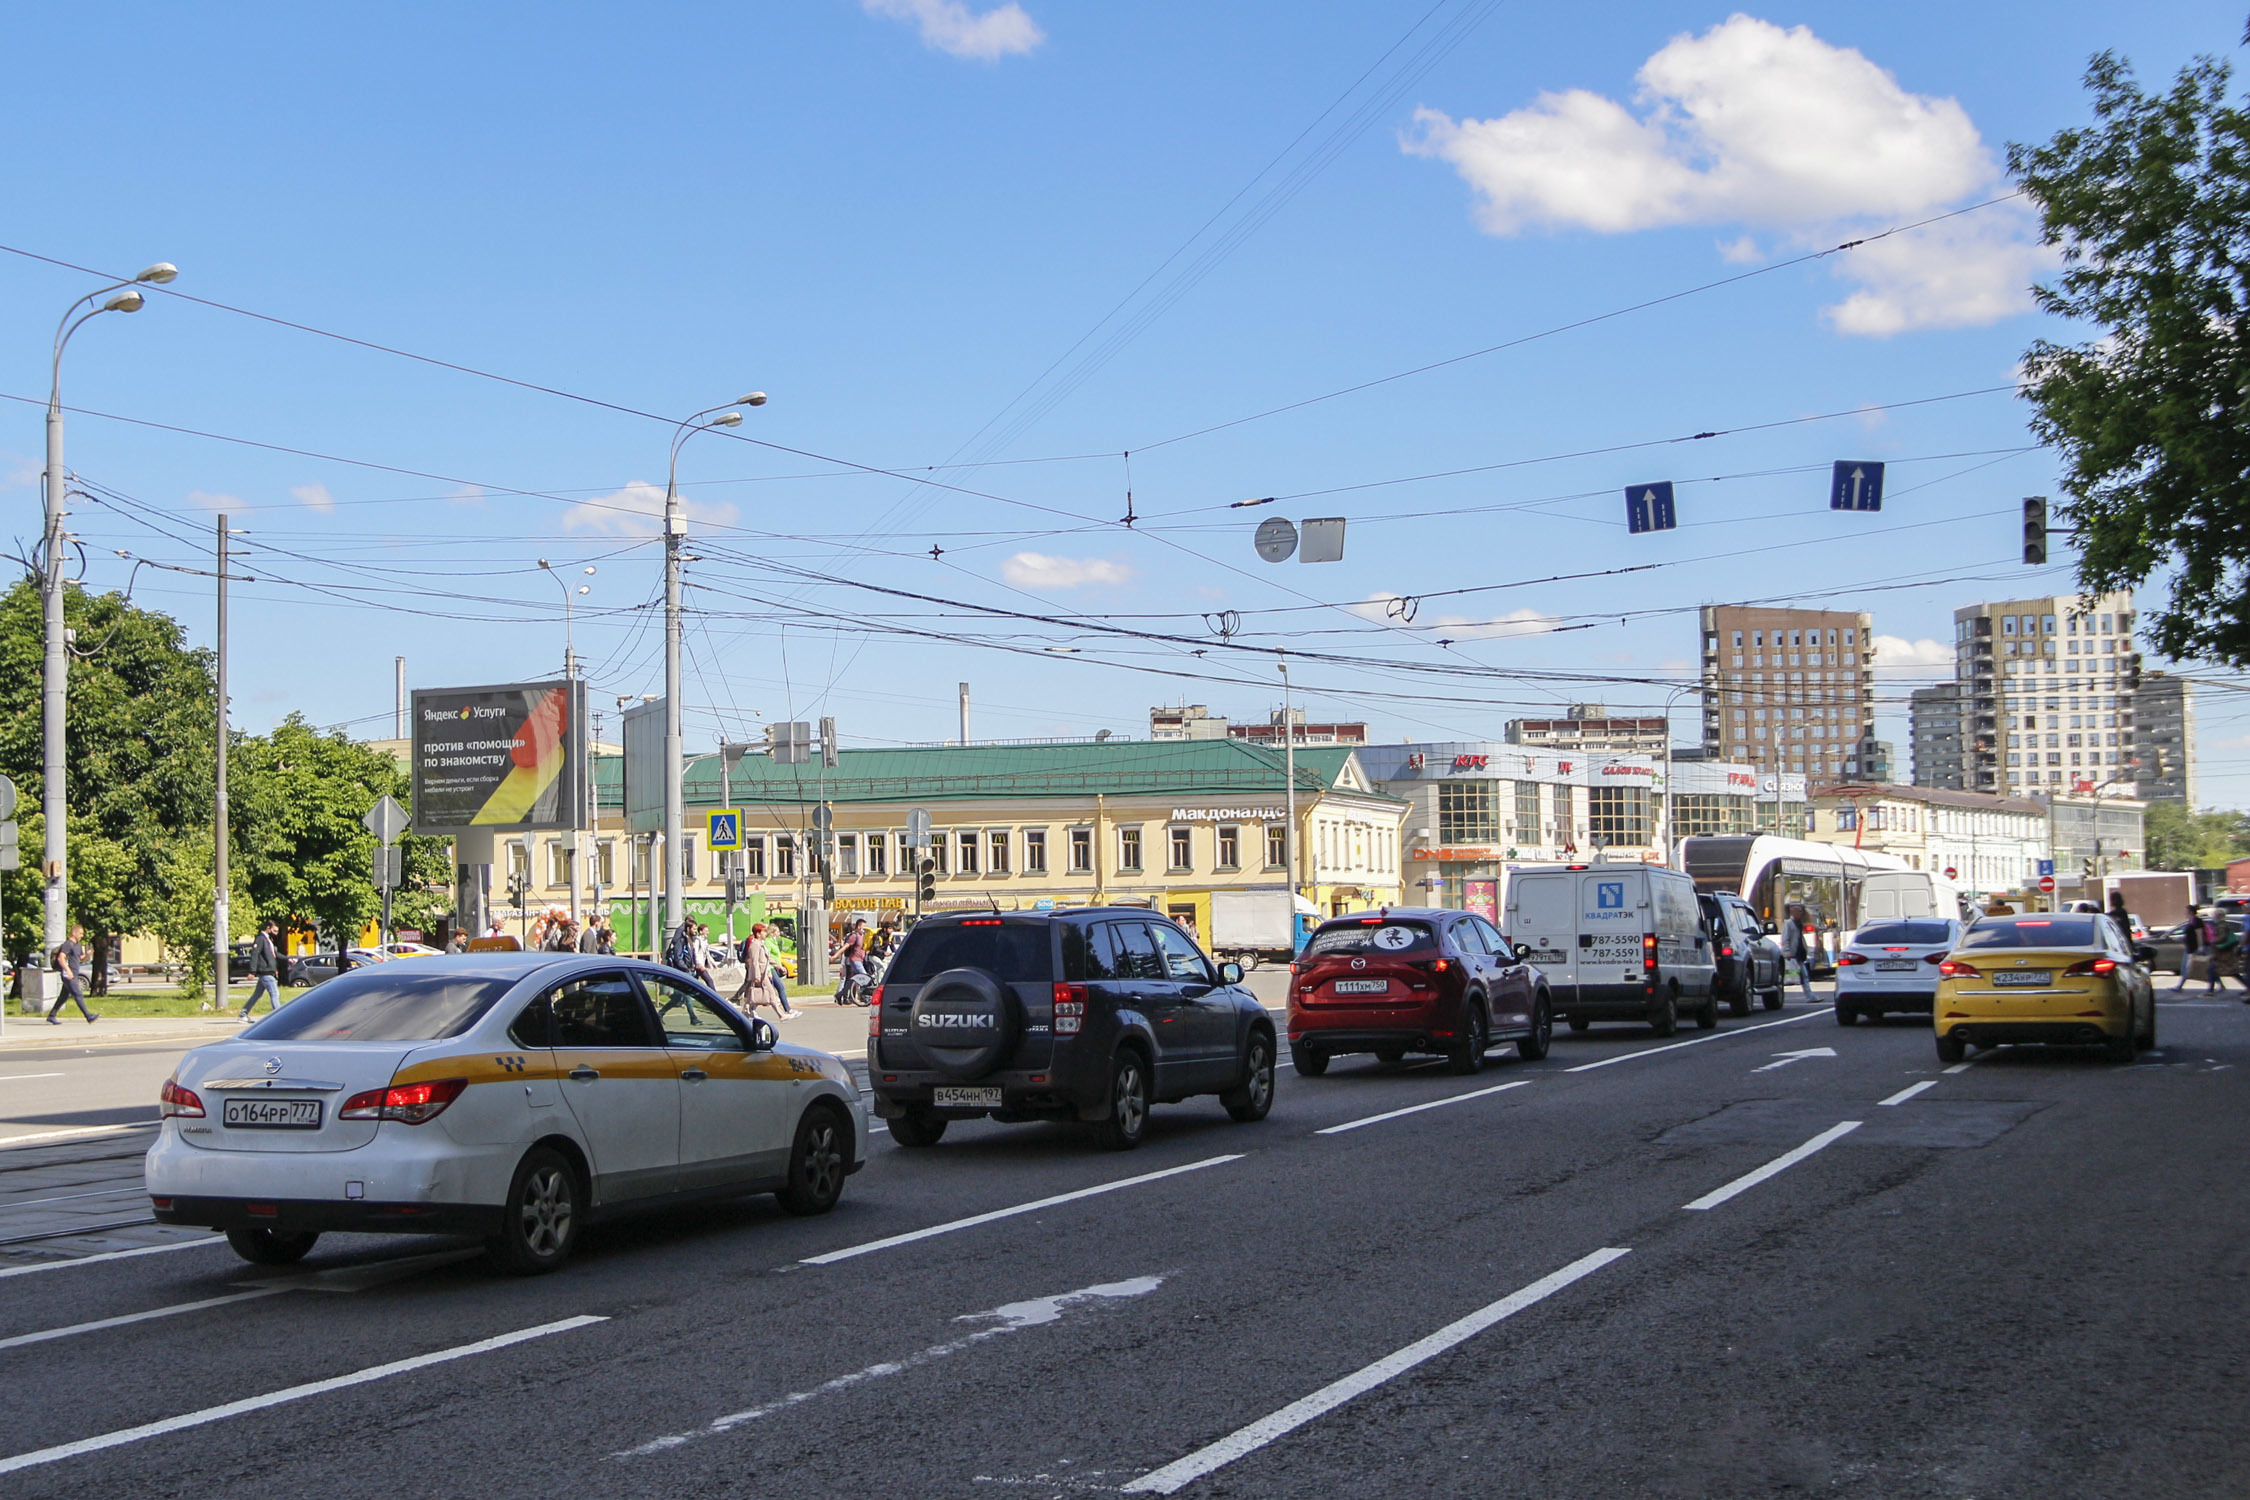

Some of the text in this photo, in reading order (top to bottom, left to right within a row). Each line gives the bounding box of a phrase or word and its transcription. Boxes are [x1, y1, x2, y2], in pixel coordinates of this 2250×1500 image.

[424, 706, 506, 722] Яндекс Услуги
[424, 739, 526, 754] против «помощи»
[424, 754, 506, 768] по знакомству
[1455, 755, 1489, 767] KFC
[480, 775, 499, 783] сборка
[1171, 807, 1287, 821] Макдоналдс
[1413, 848, 1454, 860] DNS
[1585, 912, 1634, 920] КВАДРАТЭК
[1592, 936, 1640, 945] 787-5590
[1592, 949, 1639, 957] 787-5591
[1339, 983, 1371, 991] Т111ХМ
[918, 1014, 994, 1028] SUZUKI
[937, 1088, 999, 1101] В454НН 197
[229, 1103, 316, 1123] О164РР 777
